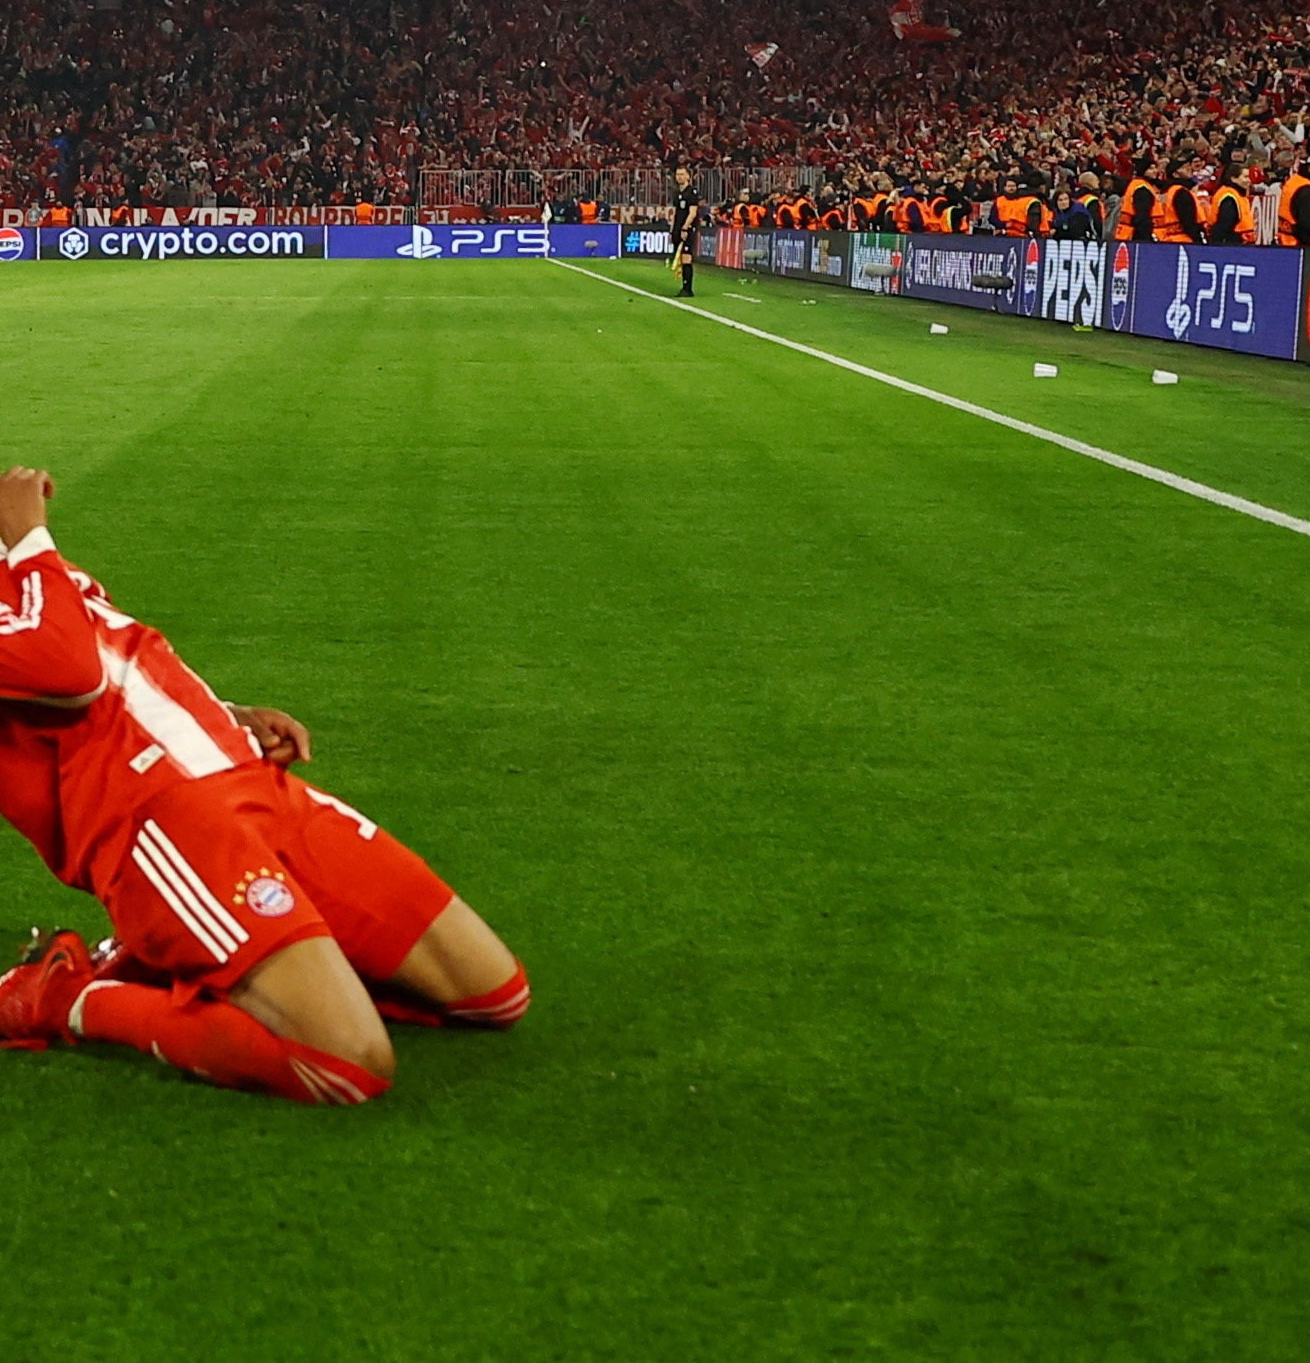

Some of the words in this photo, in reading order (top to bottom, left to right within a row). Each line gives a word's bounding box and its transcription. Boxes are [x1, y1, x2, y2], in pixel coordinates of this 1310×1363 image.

[99, 227, 303, 260] crypto.com
[450, 229, 549, 254] PS5
[1041, 239, 1107, 328] PEPSI
[1195, 261, 1257, 335] PS5
